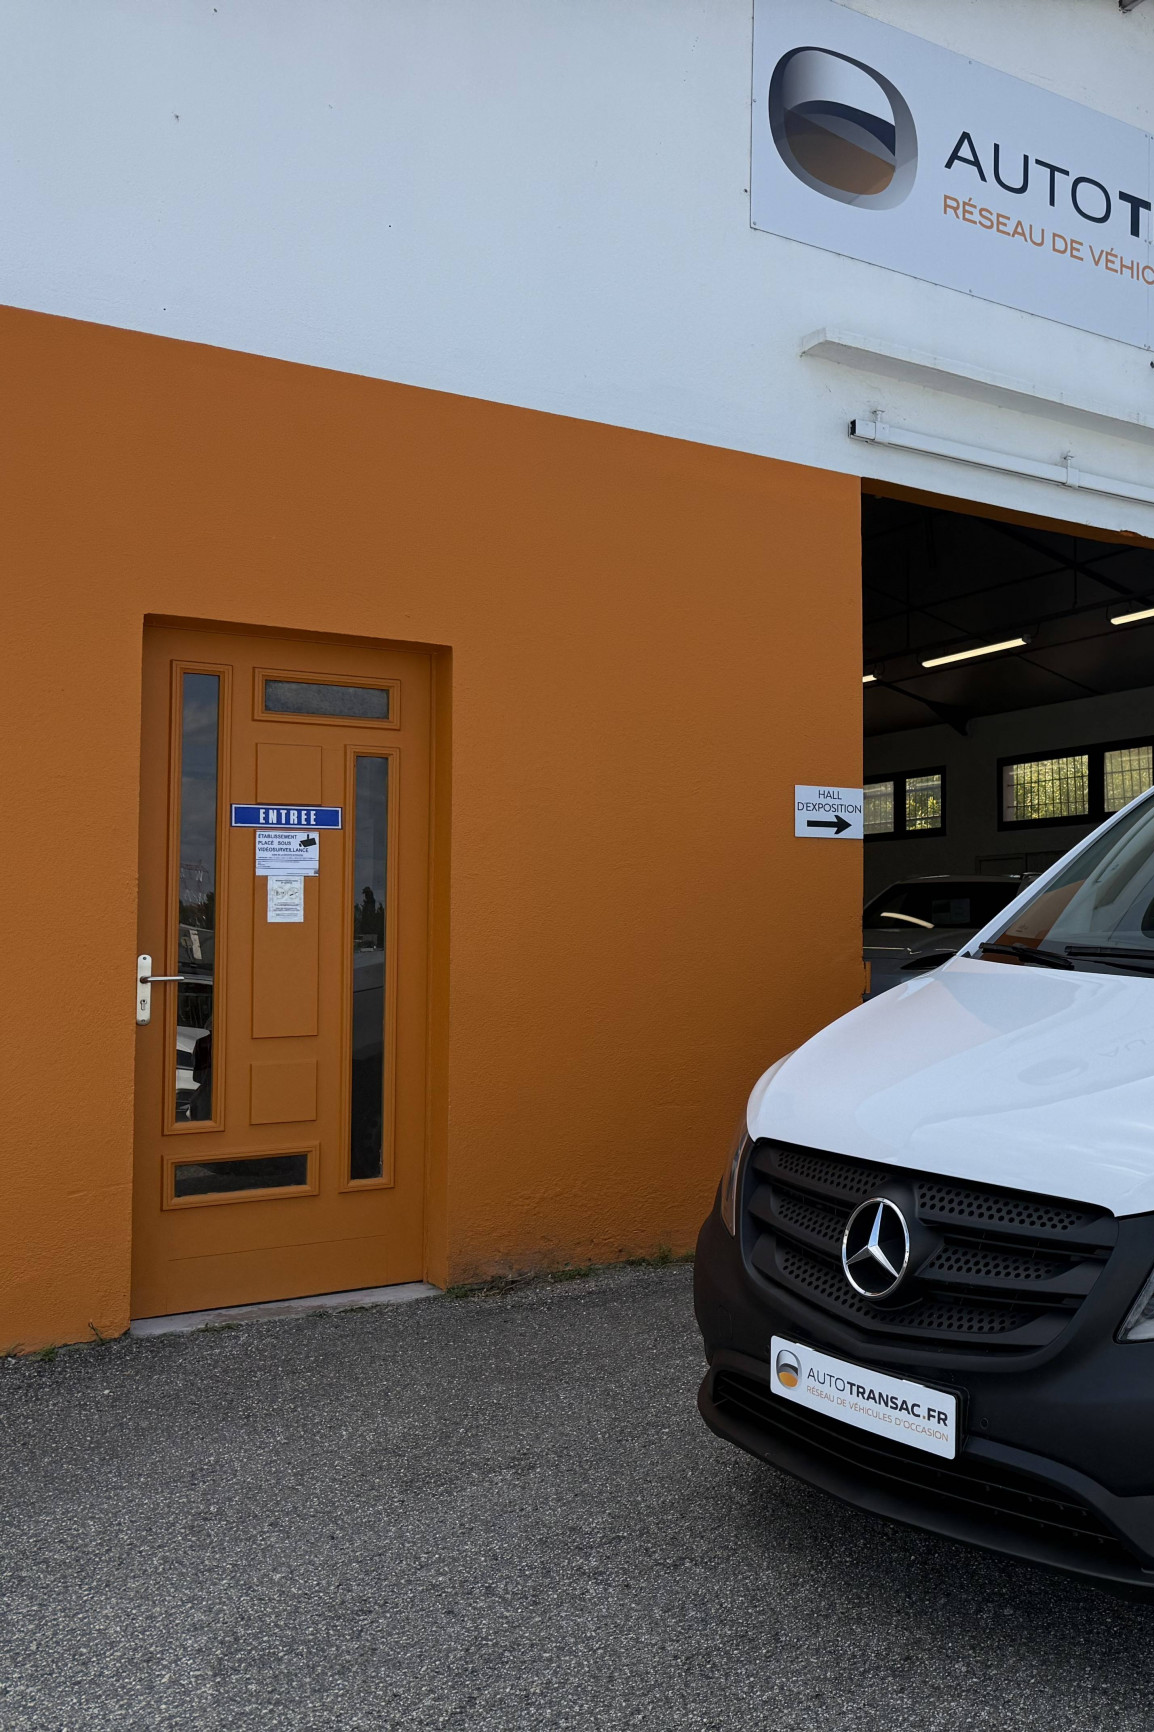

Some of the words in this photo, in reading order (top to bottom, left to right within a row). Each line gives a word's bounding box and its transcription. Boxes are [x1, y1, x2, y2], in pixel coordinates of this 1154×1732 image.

[943, 194, 1045, 247] RÉSEAU
[1052, 232, 1084, 261] DE
[797, 801, 862, 814] D'EXPOSITION
[818, 789, 842, 800] HALL
[259, 808, 316, 825] ENTREE
[806, 1385, 835, 1403] RÉSEAU
[836, 1395, 847, 1408] DE
[849, 1401, 893, 1423] VÉHICULES
[894, 1416, 949, 1442] D'OCCASION
[807, 1367, 948, 1427] AUTOTRANSAC.FR
